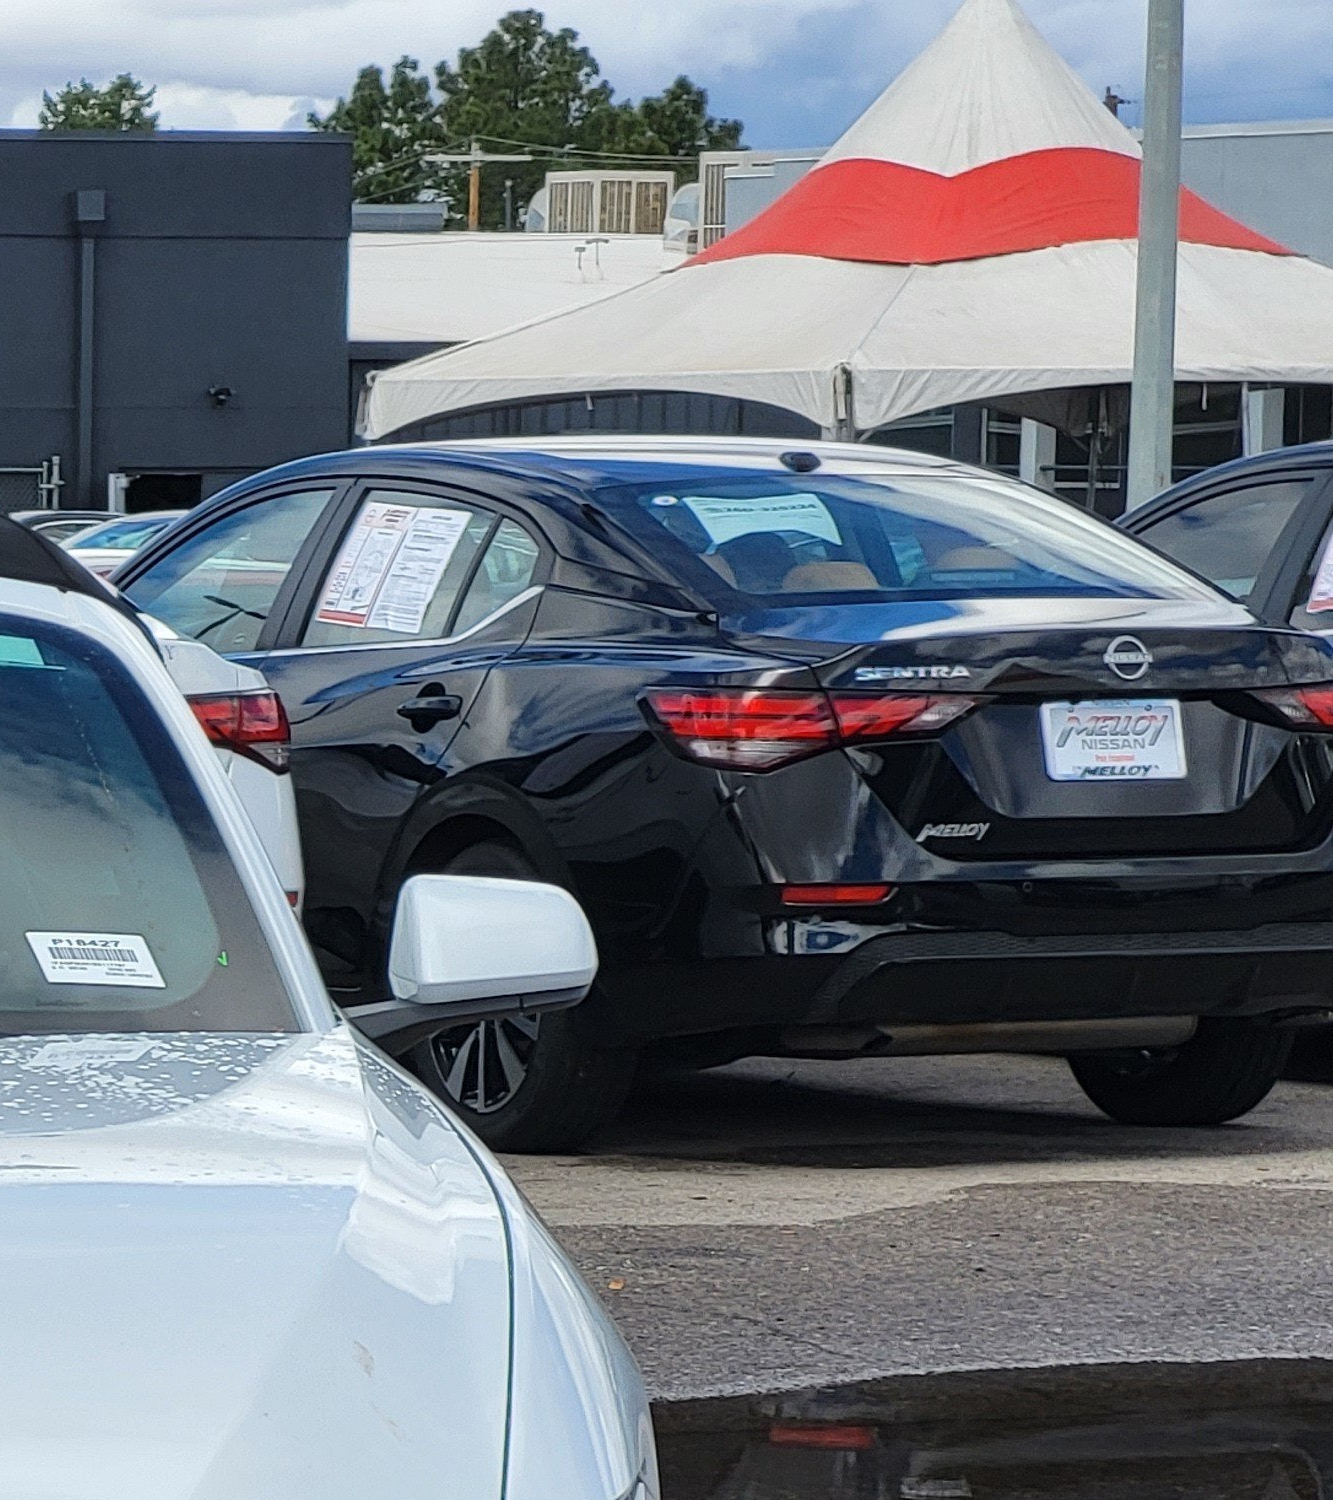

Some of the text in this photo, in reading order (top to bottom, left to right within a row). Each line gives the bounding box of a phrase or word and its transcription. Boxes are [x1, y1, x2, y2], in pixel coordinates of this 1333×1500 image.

[854, 665, 971, 681] SENTRA
[1056, 715, 1168, 748] MELLOY
[1081, 738, 1146, 750] NISSAN
[915, 822, 991, 842] MELLOY
[51, 938, 121, 948] P18427
